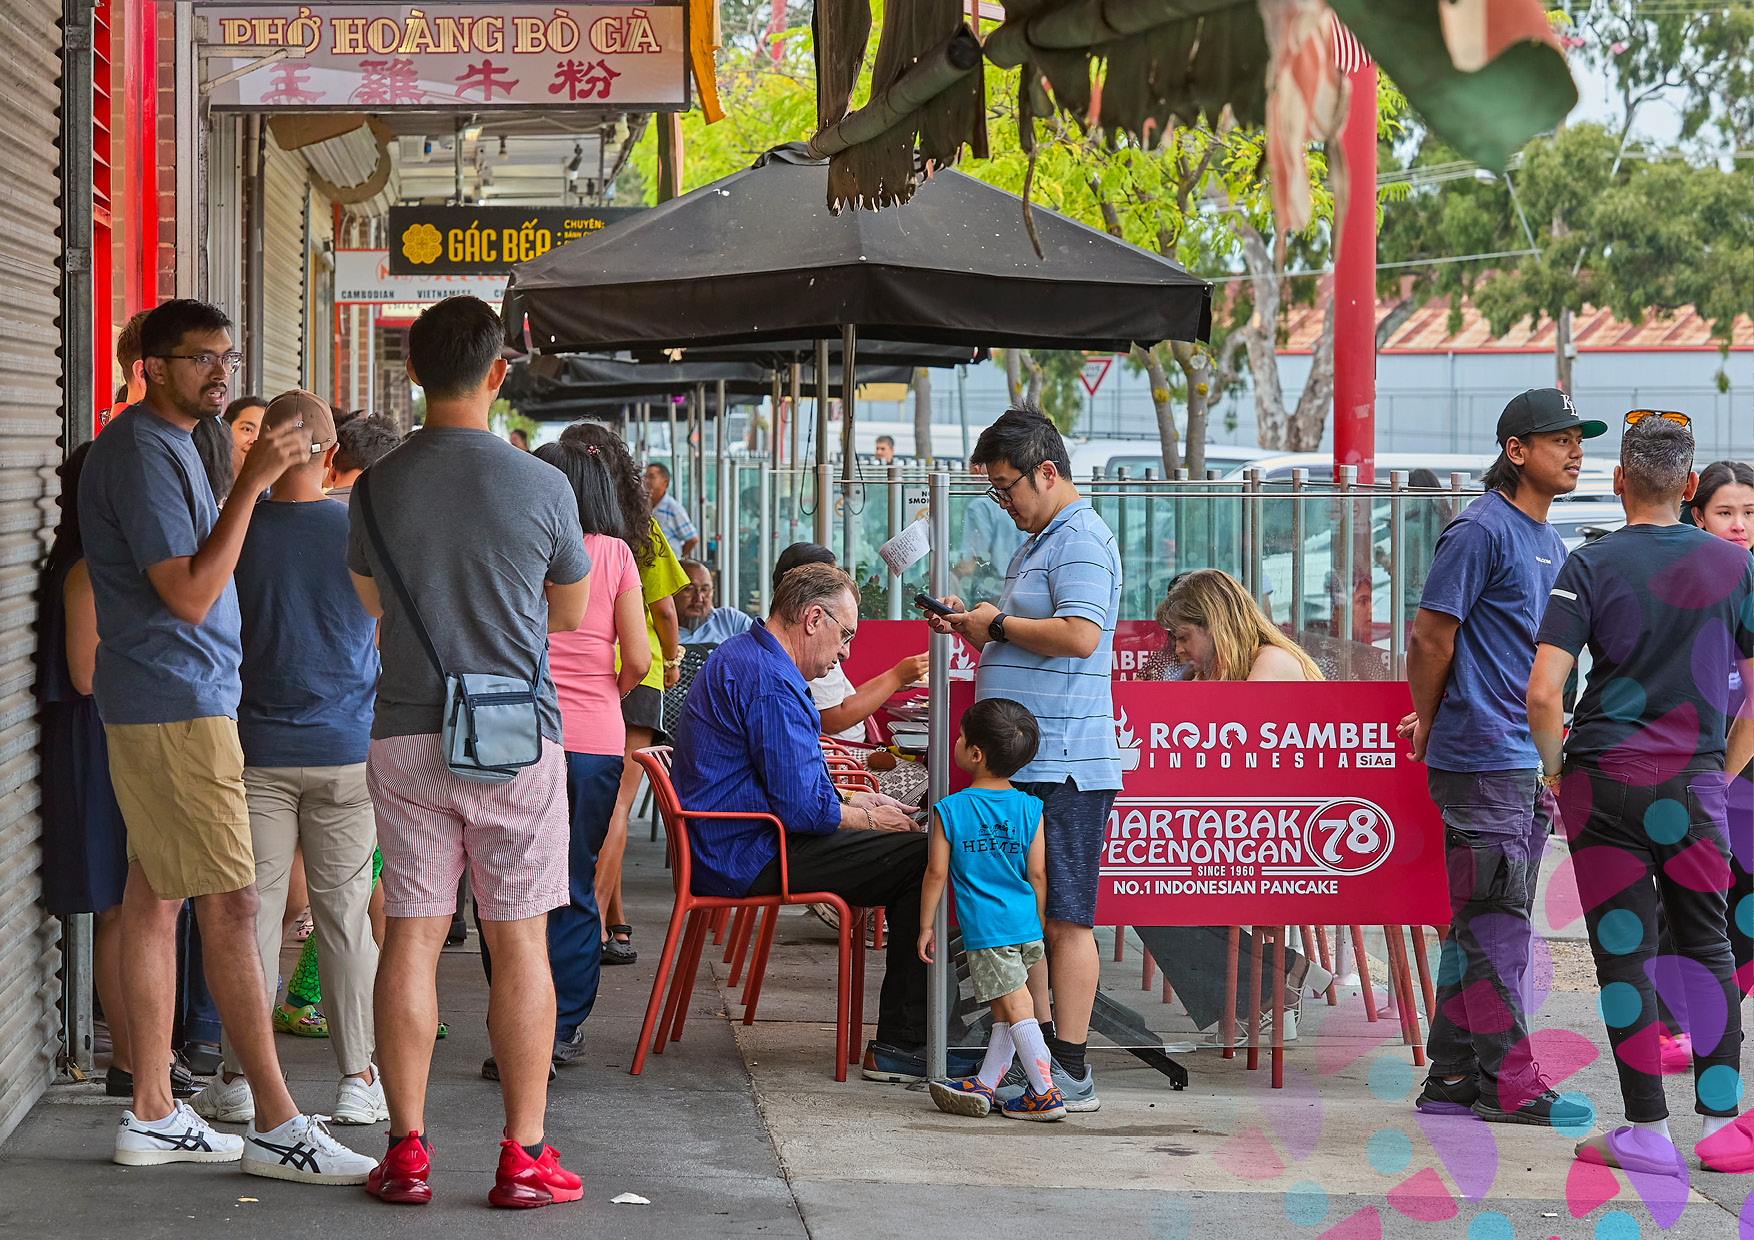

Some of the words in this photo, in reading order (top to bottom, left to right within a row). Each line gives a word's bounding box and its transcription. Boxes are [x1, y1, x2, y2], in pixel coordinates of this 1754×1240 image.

[330, 9, 504, 55] HOÀNG
[512, 8, 580, 54] BÒ
[589, 8, 662, 54] GÀ
[448, 219, 497, 262] GÁC
[341, 290, 395, 299] CAMBODIAN
[1150, 722, 1248, 749] ROJO
[1259, 722, 1396, 749] SAMBEL
[1149, 752, 1349, 768] INDONESIA
[1359, 754, 1393, 766] SiAa
[1318, 808, 1380, 863] 78
[1102, 840, 1301, 864] ECENONGAN
[1197, 866, 1226, 876] SINCE
[1230, 866, 1255, 876] 1960
[1113, 880, 1151, 895] NO.1
[1155, 880, 1257, 895] INDONESIAN
[1261, 880, 1338, 895] PANCAKE
